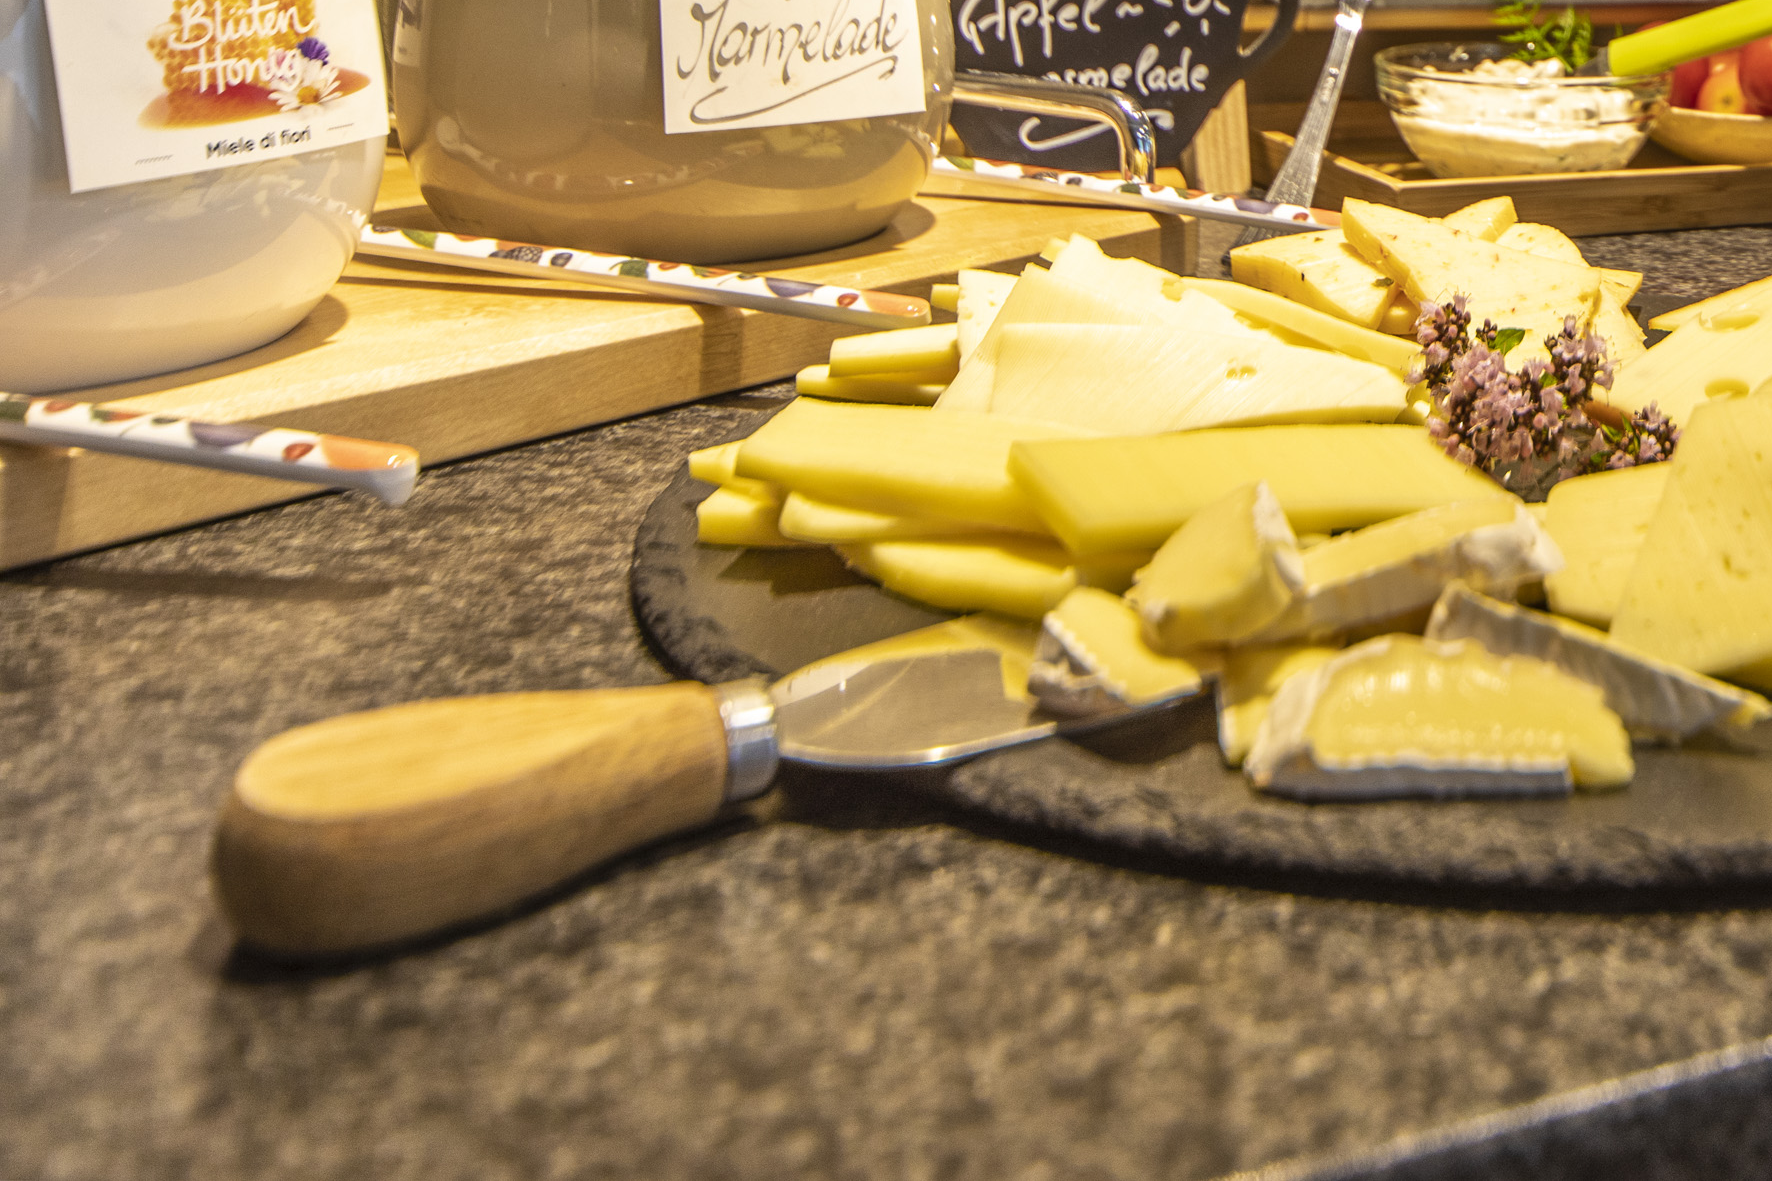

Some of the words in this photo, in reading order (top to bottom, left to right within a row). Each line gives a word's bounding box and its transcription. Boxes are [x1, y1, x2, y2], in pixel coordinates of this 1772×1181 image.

[181, 45, 304, 96] Honig
[205, 134, 256, 160] Miele
[259, 130, 276, 148] di
[279, 125, 312, 145] fiori
